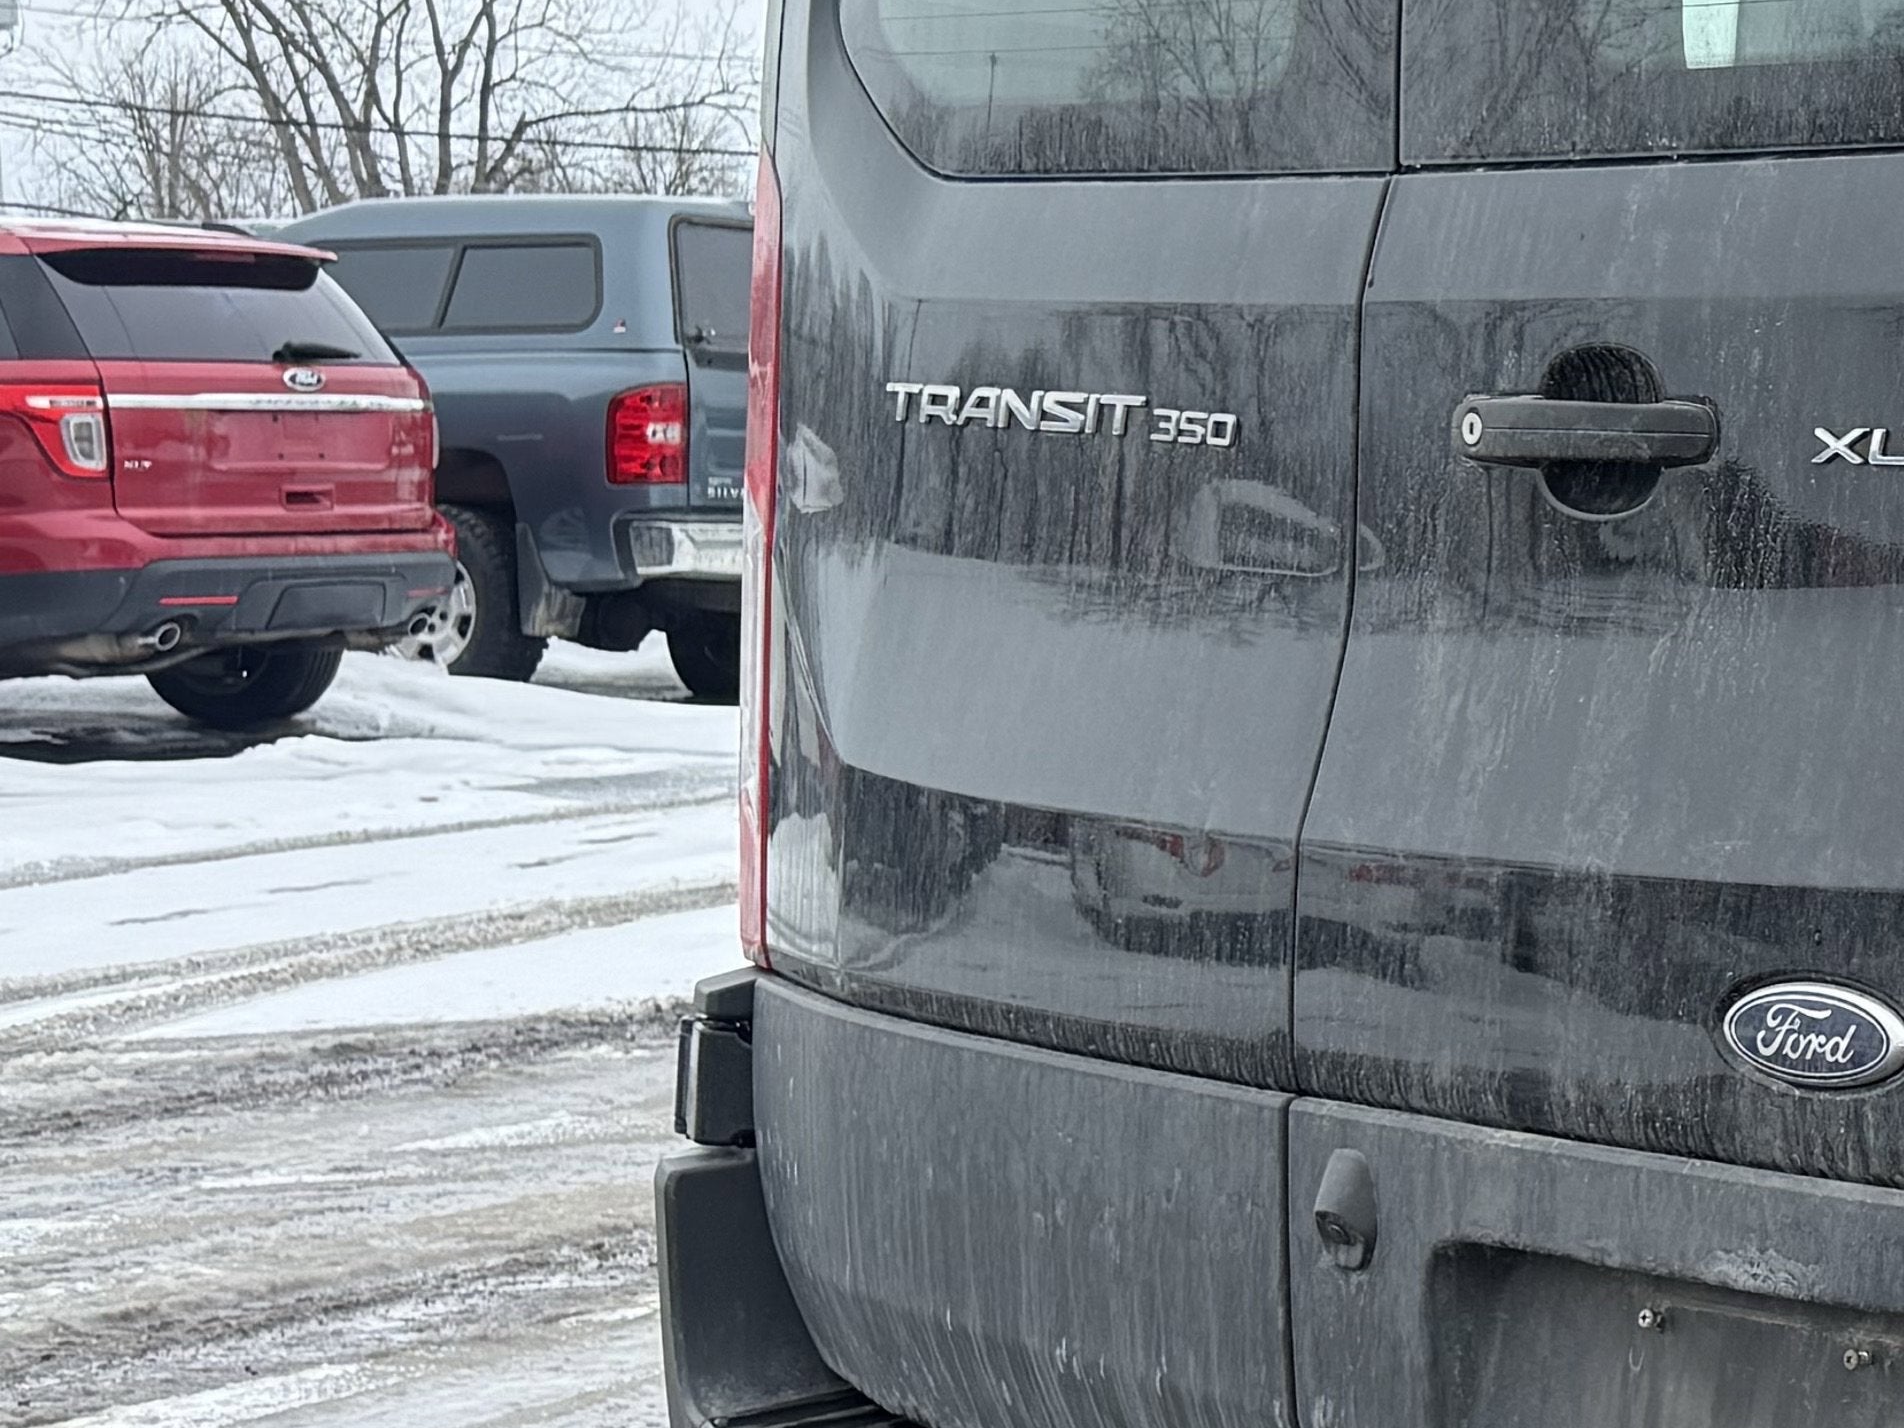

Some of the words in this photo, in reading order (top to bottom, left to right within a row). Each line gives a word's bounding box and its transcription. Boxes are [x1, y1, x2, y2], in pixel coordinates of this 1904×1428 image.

[886, 382, 1147, 436] TRANSIT
[1150, 408, 1240, 447] 350
[1757, 1003, 1857, 1063] Ford
